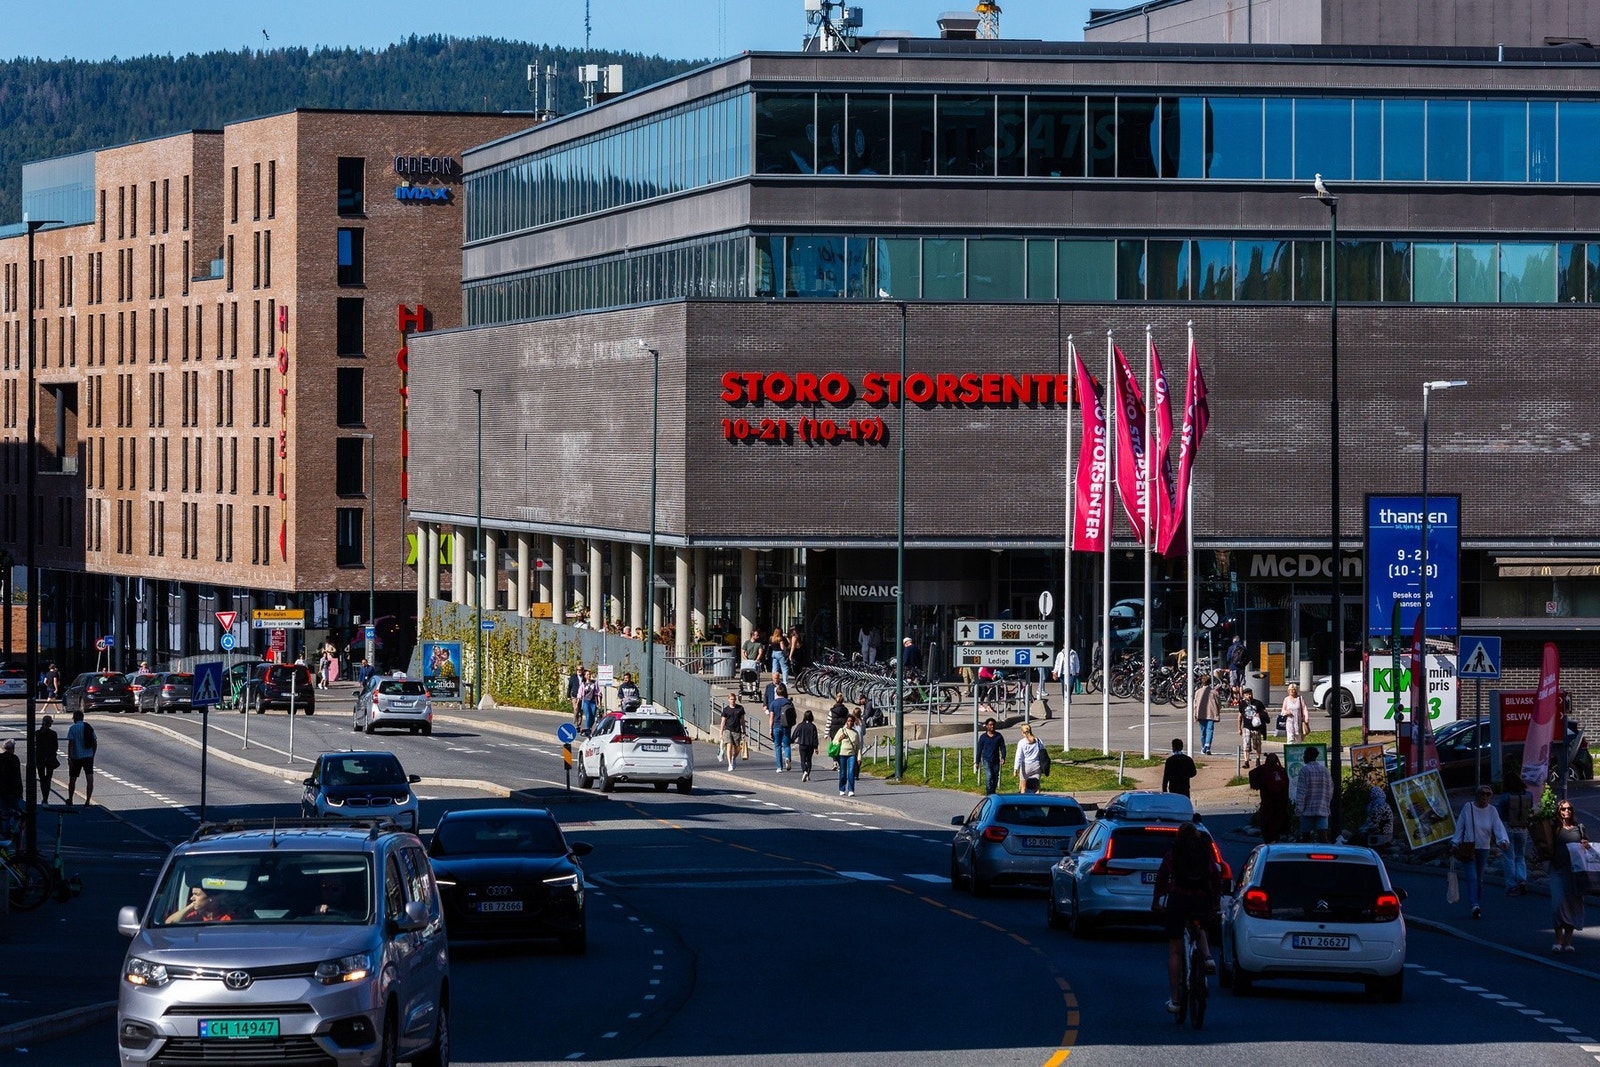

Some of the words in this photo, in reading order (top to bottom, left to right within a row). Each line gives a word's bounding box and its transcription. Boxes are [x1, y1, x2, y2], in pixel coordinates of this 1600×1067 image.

[984, 113, 1124, 160] SATS
[395, 156, 453, 175] ODEON
[395, 186, 449, 200] IMAX
[720, 371, 850, 403] STORO
[861, 371, 1099, 404] STORSENTE
[721, 417, 787, 440] 10-21
[798, 415, 884, 442] (10-19)
[1414, 549, 1430, 561] 2
[839, 584, 899, 597] INNGANG
[1392, 591, 1412, 599] Besøk
[1001, 622, 1021, 630] Storo
[1027, 632, 1049, 640] Ledige
[962, 647, 982, 656] Storo
[1429, 667, 1452, 678] mini
[1429, 681, 1450, 693] pris
[1505, 697, 1534, 705] BILVASK
[483, 903, 493, 911] EB
[1301, 937, 1312, 946] AY
[1318, 938, 1347, 947] 26627
[211, 1022, 229, 1035] CH
[234, 1021, 275, 1035] 14947
